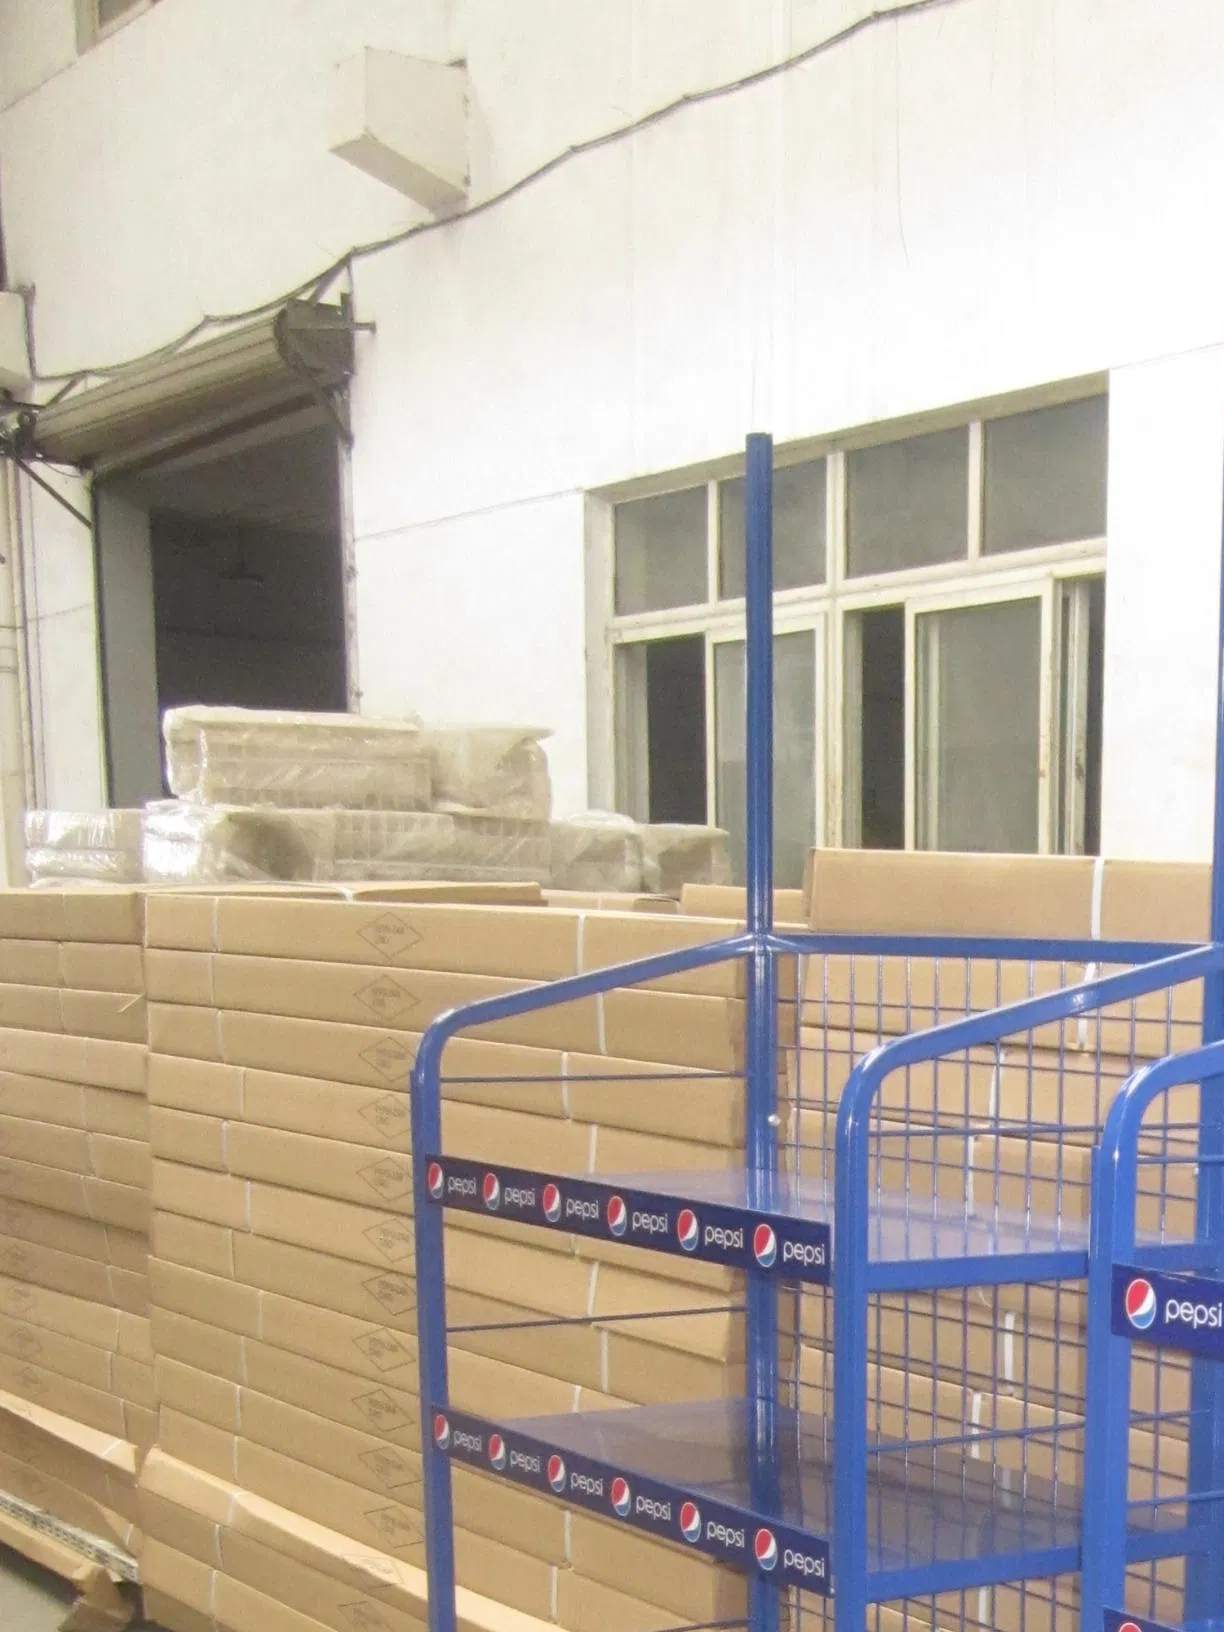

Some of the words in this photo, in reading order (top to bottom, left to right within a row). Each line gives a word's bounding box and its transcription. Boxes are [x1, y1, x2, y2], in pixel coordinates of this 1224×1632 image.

[448, 1174, 477, 1196] pepsi
[504, 1185, 536, 1207] pepsi
[566, 1196, 599, 1220] pepsi
[632, 1211, 668, 1234] pepsi
[704, 1224, 744, 1250] pepsi
[783, 1237, 826, 1266] pepsi
[1164, 1298, 1223, 1330] pepsi
[453, 1431, 482, 1452] pepsi
[510, 1449, 541, 1473] pepsi
[570, 1470, 604, 1497] pepsi
[635, 1493, 672, 1522] pepsi
[706, 1519, 746, 1549] pepsi
[783, 1547, 826, 1578] pepsi
